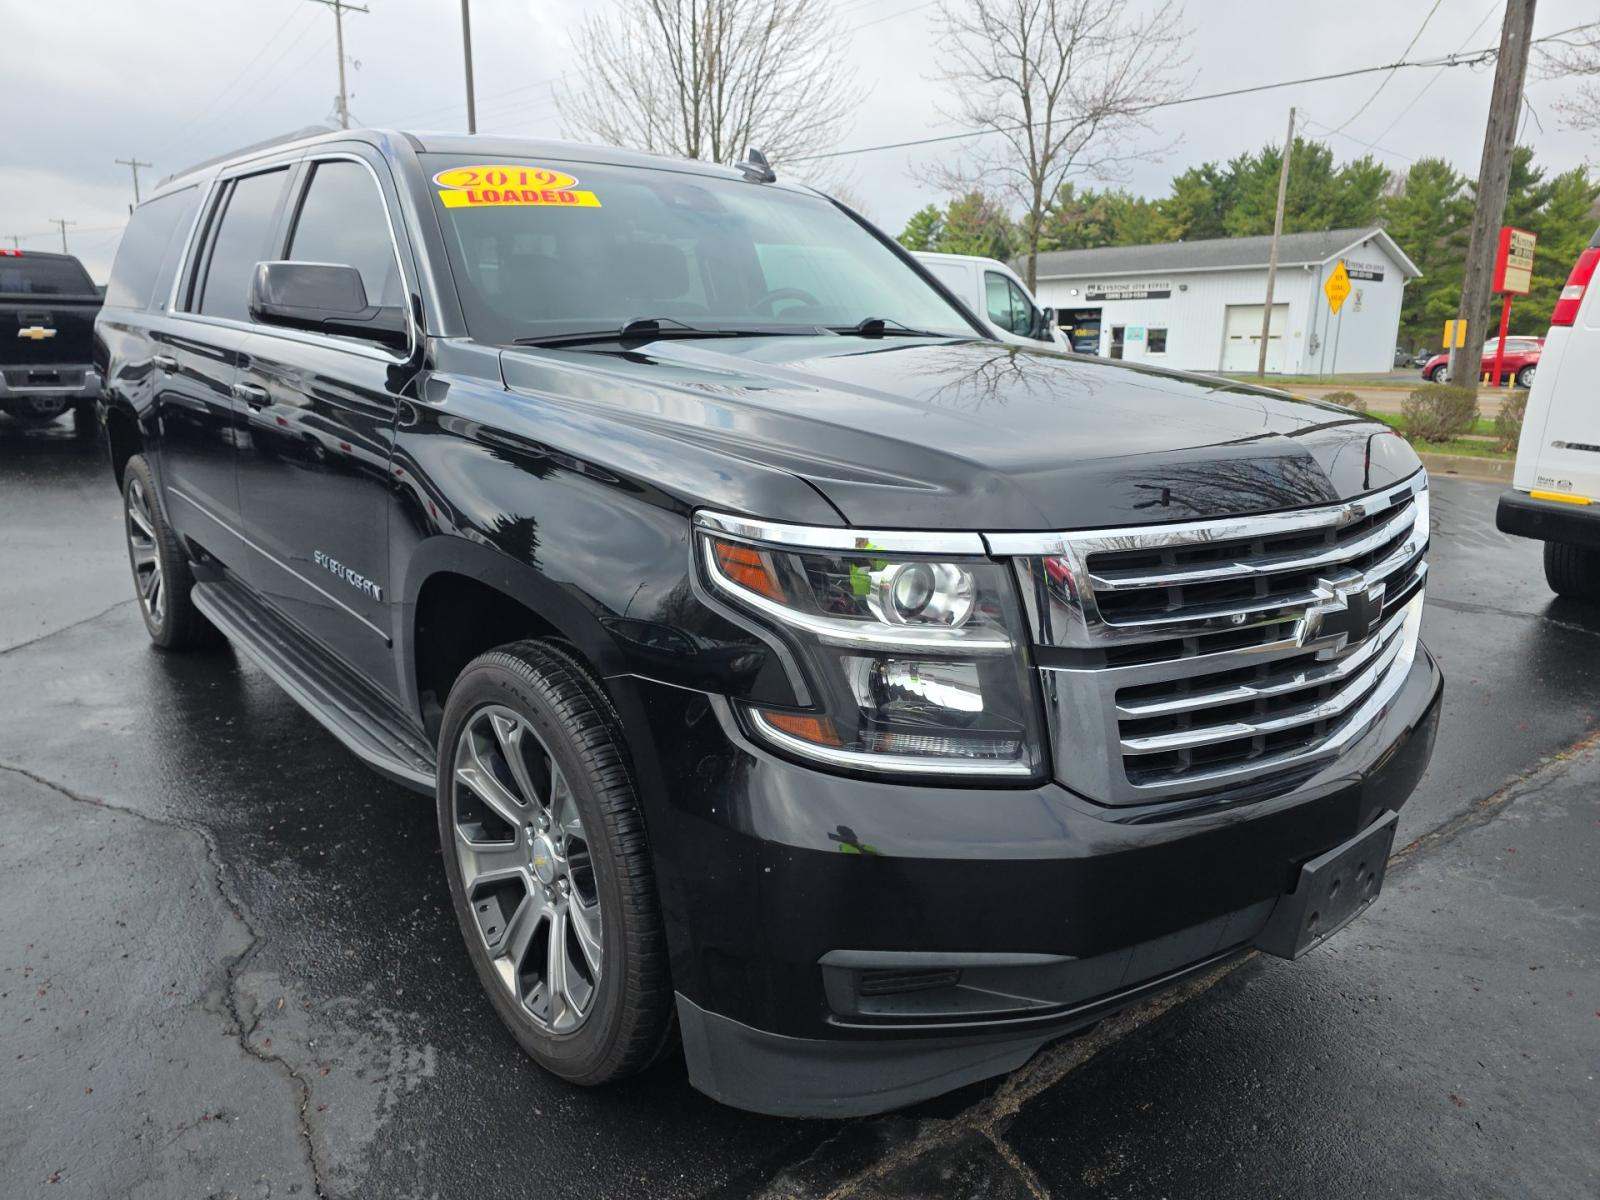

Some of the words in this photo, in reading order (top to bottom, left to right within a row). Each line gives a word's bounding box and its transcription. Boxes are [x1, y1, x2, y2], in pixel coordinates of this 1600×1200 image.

[459, 170, 557, 187] 2019
[466, 189, 579, 205] LOADED
[313, 549, 383, 602] SUBURBAN
